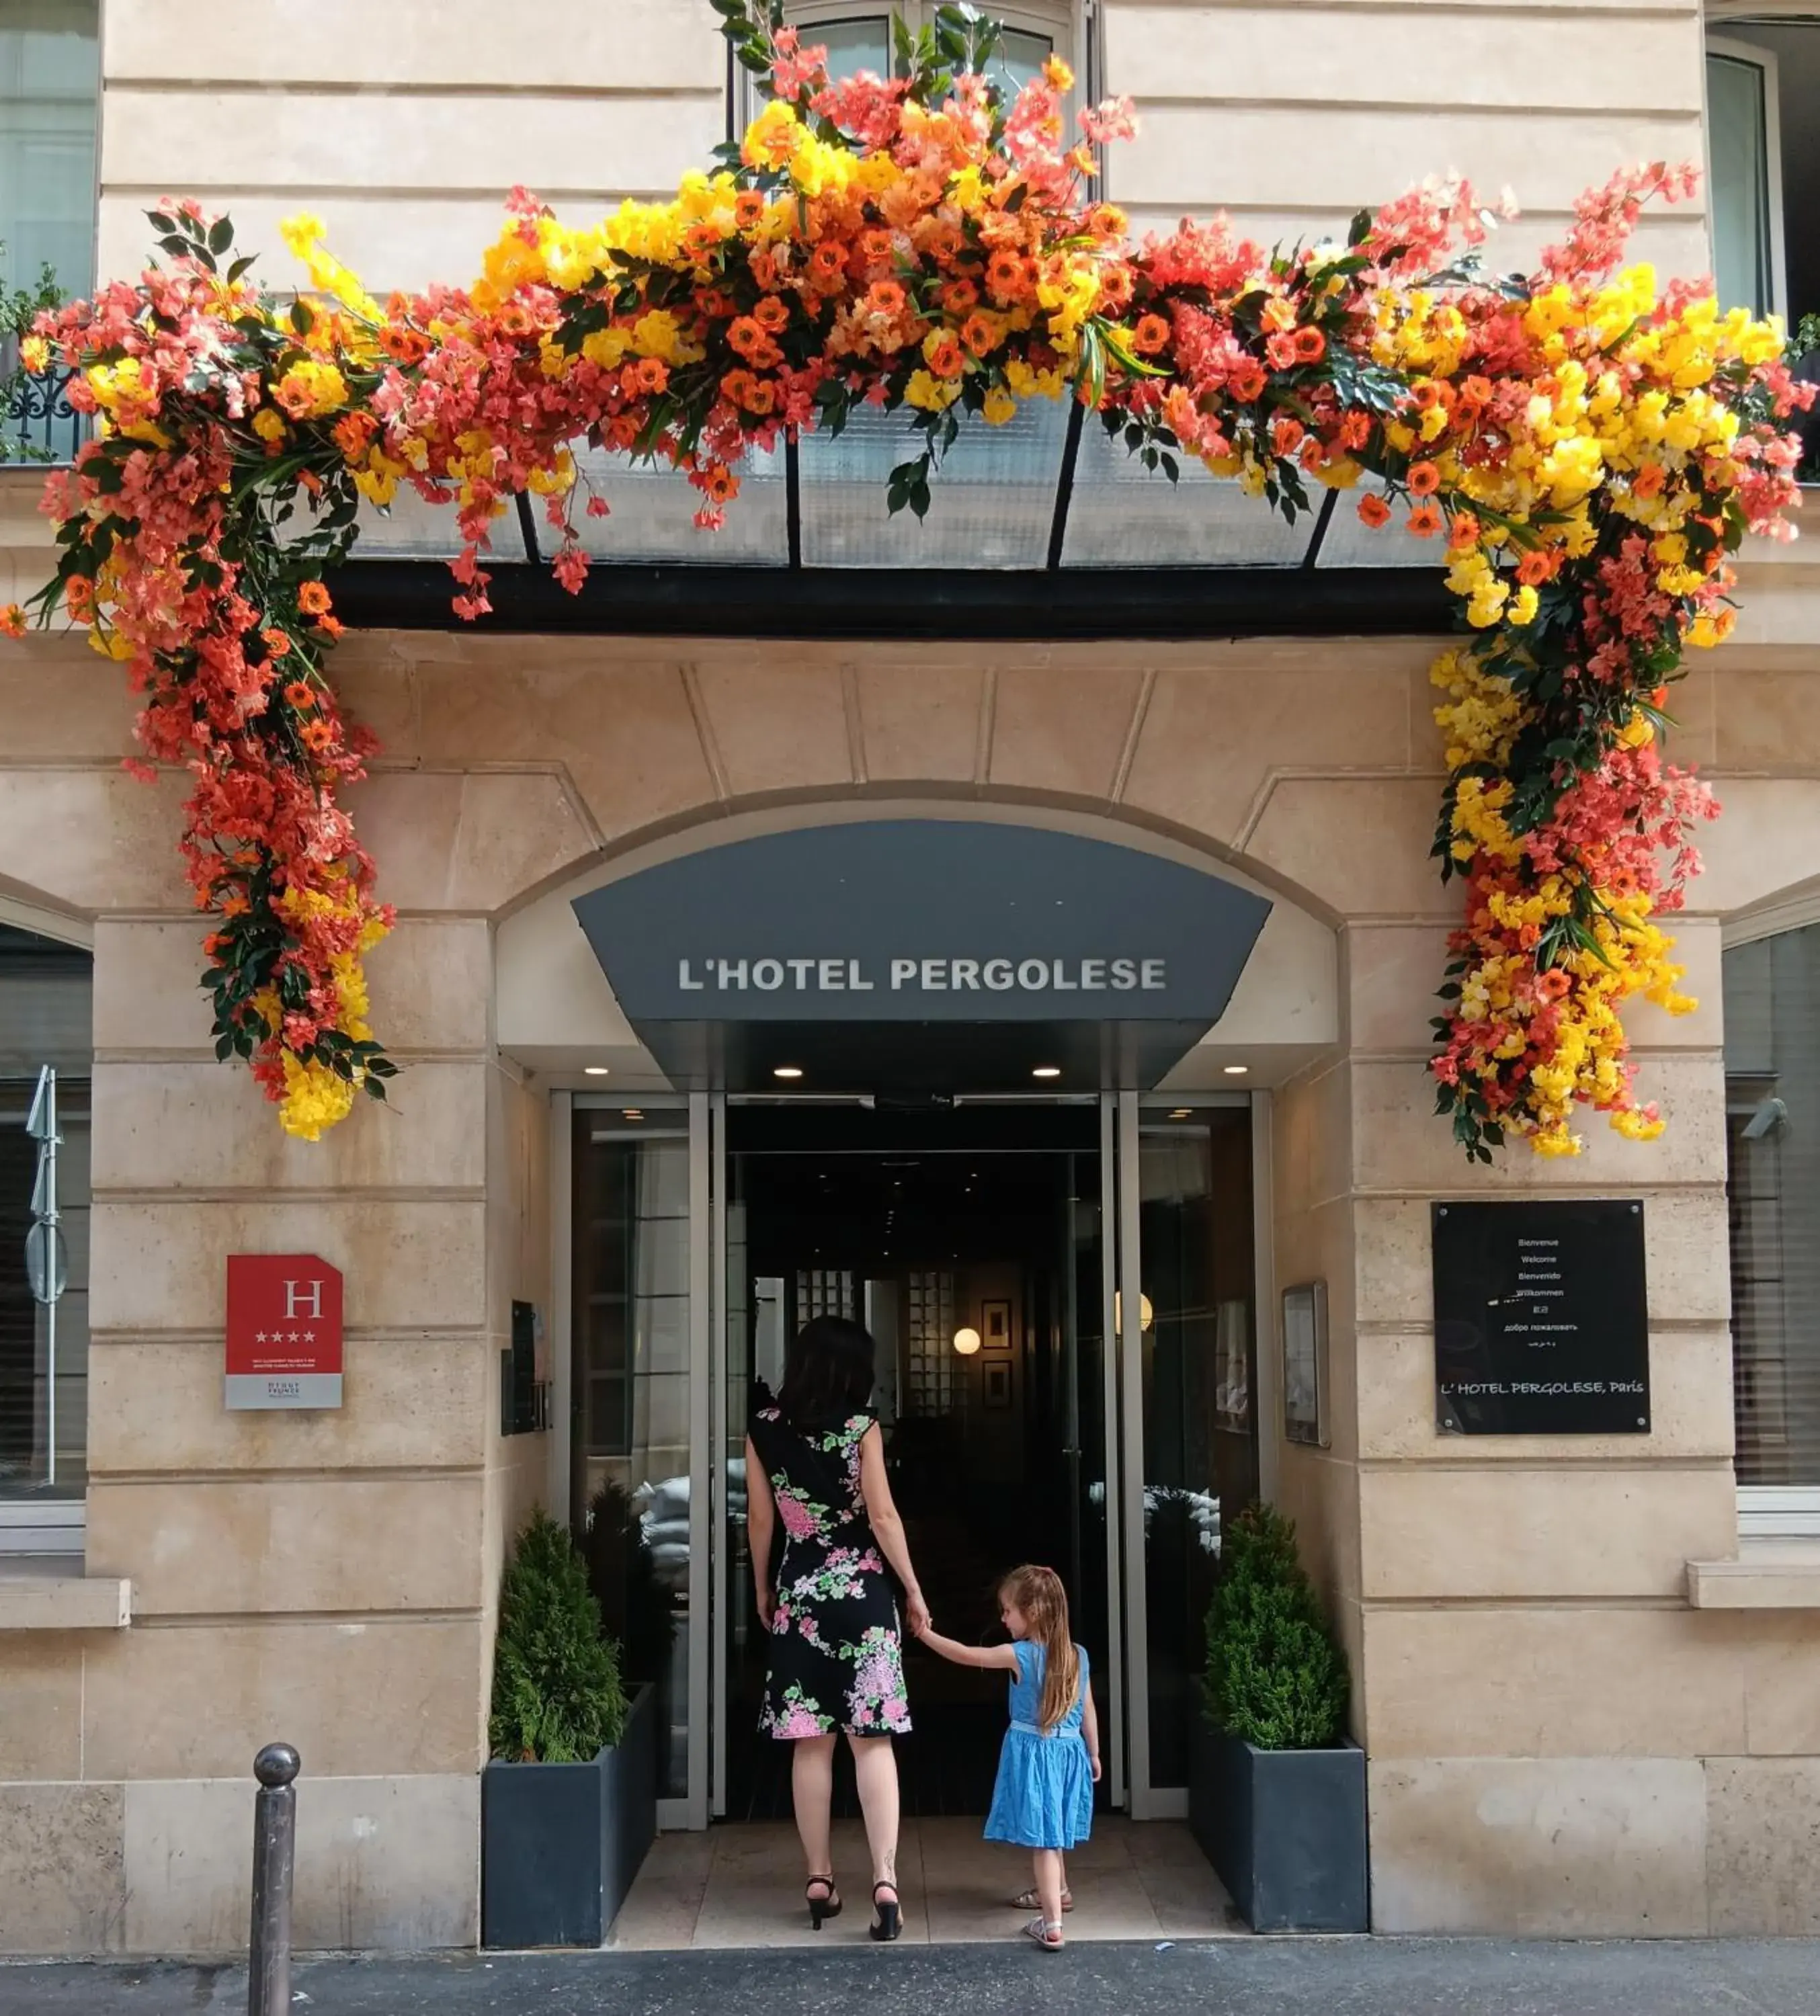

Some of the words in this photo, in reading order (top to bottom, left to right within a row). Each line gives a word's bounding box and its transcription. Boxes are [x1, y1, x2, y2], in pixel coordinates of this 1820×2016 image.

[678, 959, 874, 991] L'HOTEL
[891, 958, 1165, 991] PERGOLESE
[1518, 1238, 1559, 1247] Bienvenue
[1521, 1255, 1557, 1263] Welcome
[1518, 1271, 1561, 1280] Bienvenido
[282, 1280, 325, 1319] H
[1609, 1380, 1645, 1393] Paris
